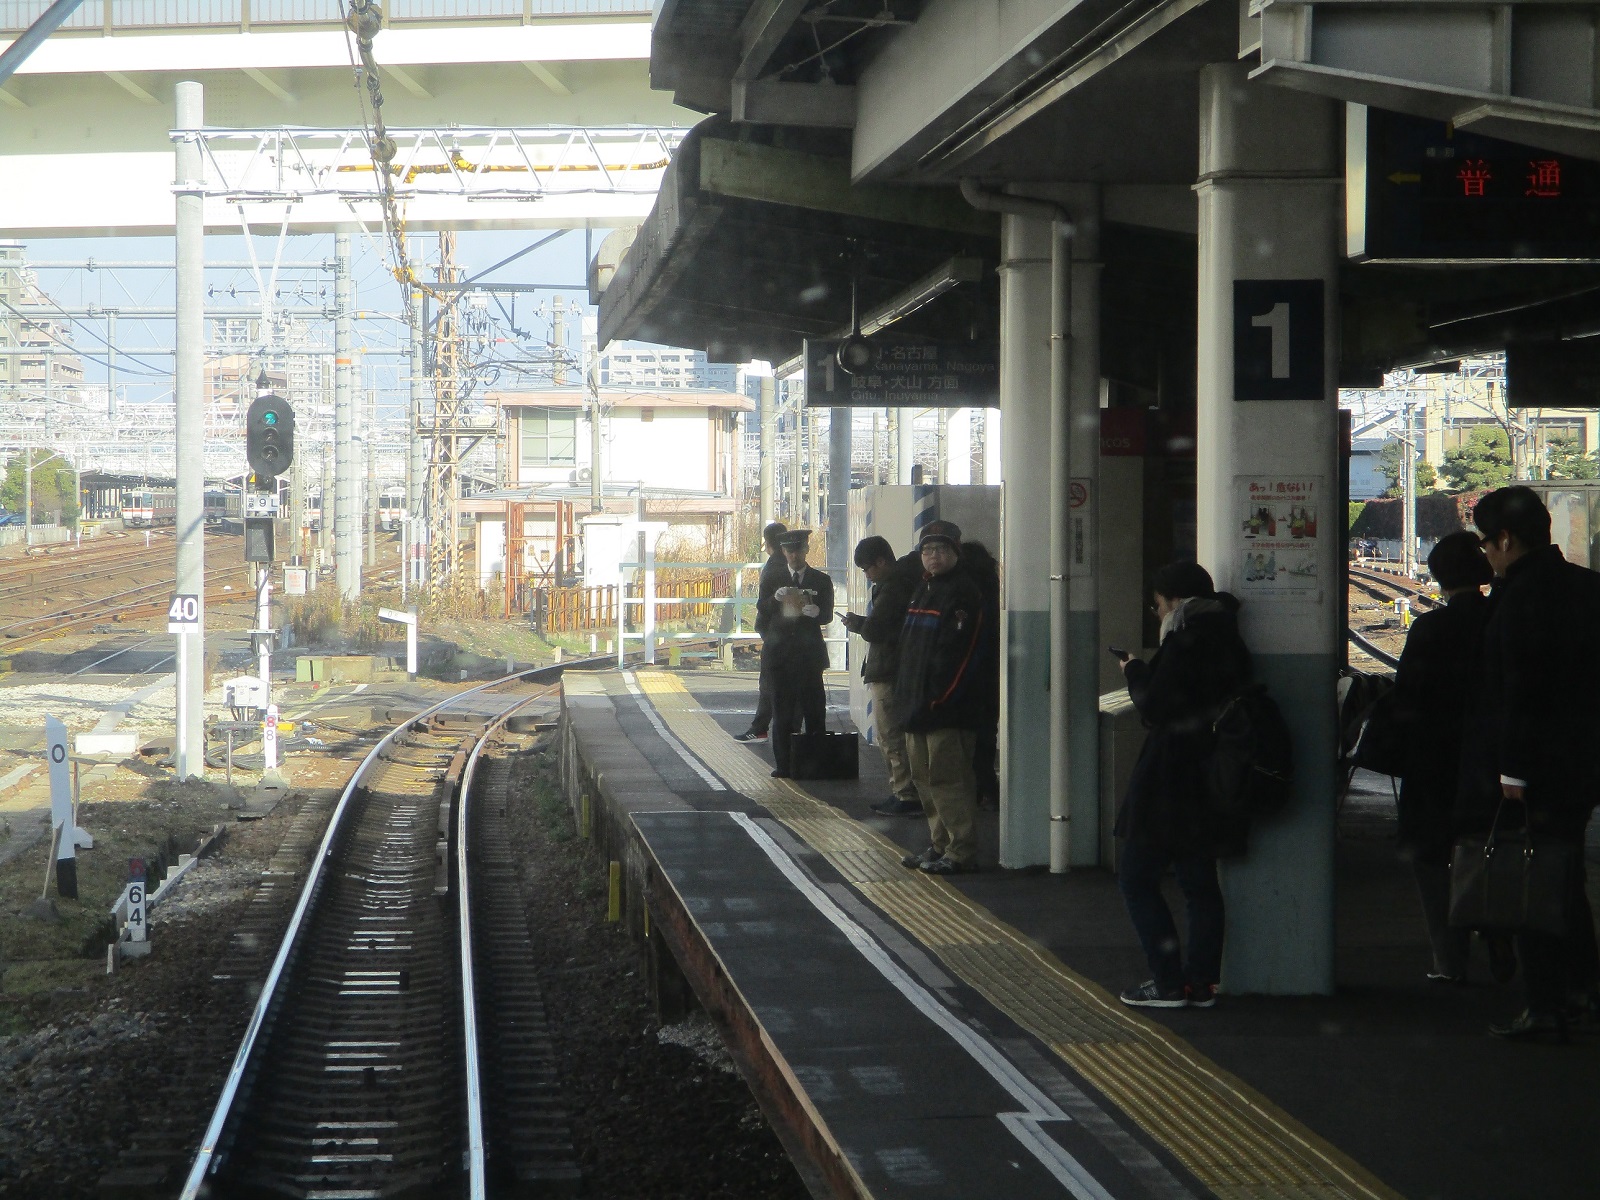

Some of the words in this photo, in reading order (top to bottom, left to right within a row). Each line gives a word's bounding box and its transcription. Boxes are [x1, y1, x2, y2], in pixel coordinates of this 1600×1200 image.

[1456, 159, 1561, 197] 普通
[1251, 302, 1290, 379] 1
[817, 353, 835, 392] 1
[259, 498, 267, 508] 9
[270, 498, 279, 508] L
[169, 597, 198, 621] 40
[266, 729, 274, 741] 8
[51, 743, 66, 764] 0
